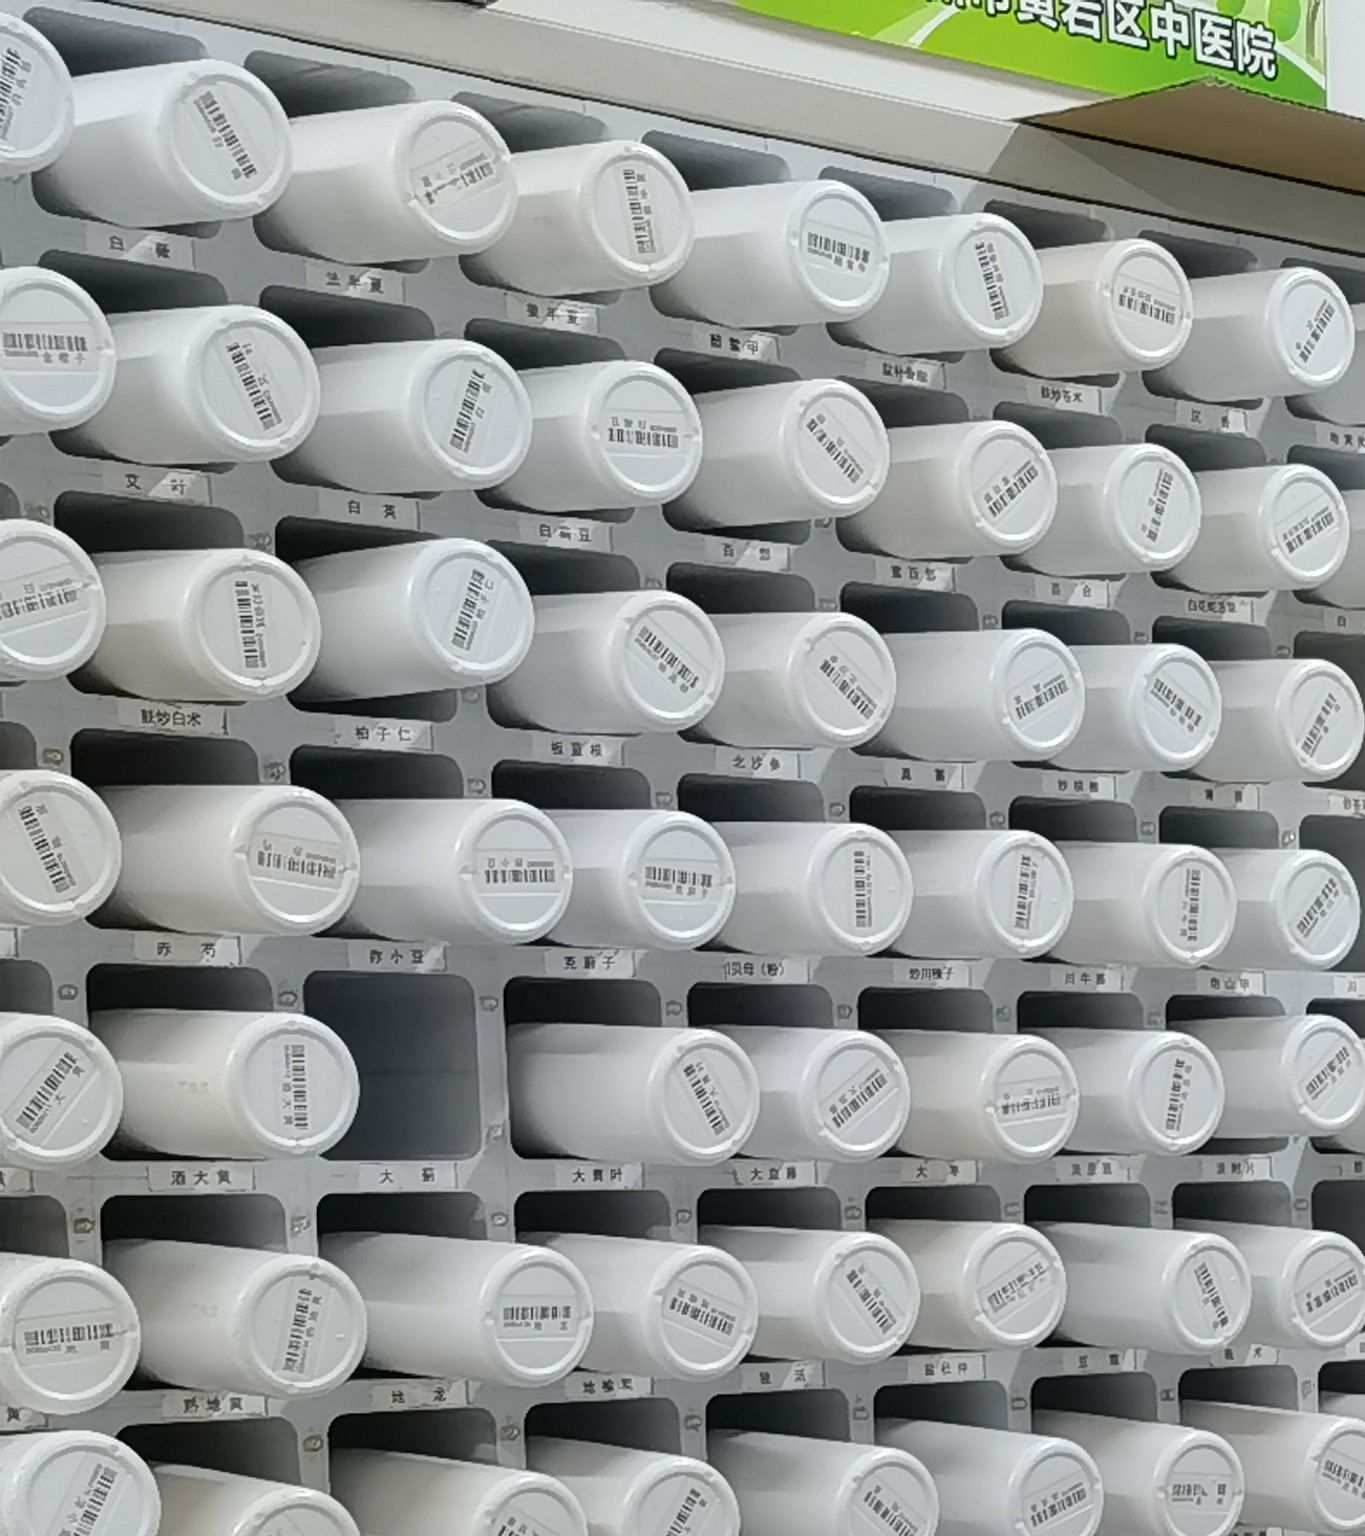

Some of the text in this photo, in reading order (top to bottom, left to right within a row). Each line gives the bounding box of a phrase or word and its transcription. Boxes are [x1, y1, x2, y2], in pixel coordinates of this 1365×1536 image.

[355, 726, 412, 740] 柏子仁
[172, 1170, 231, 1184] 酒大黄
